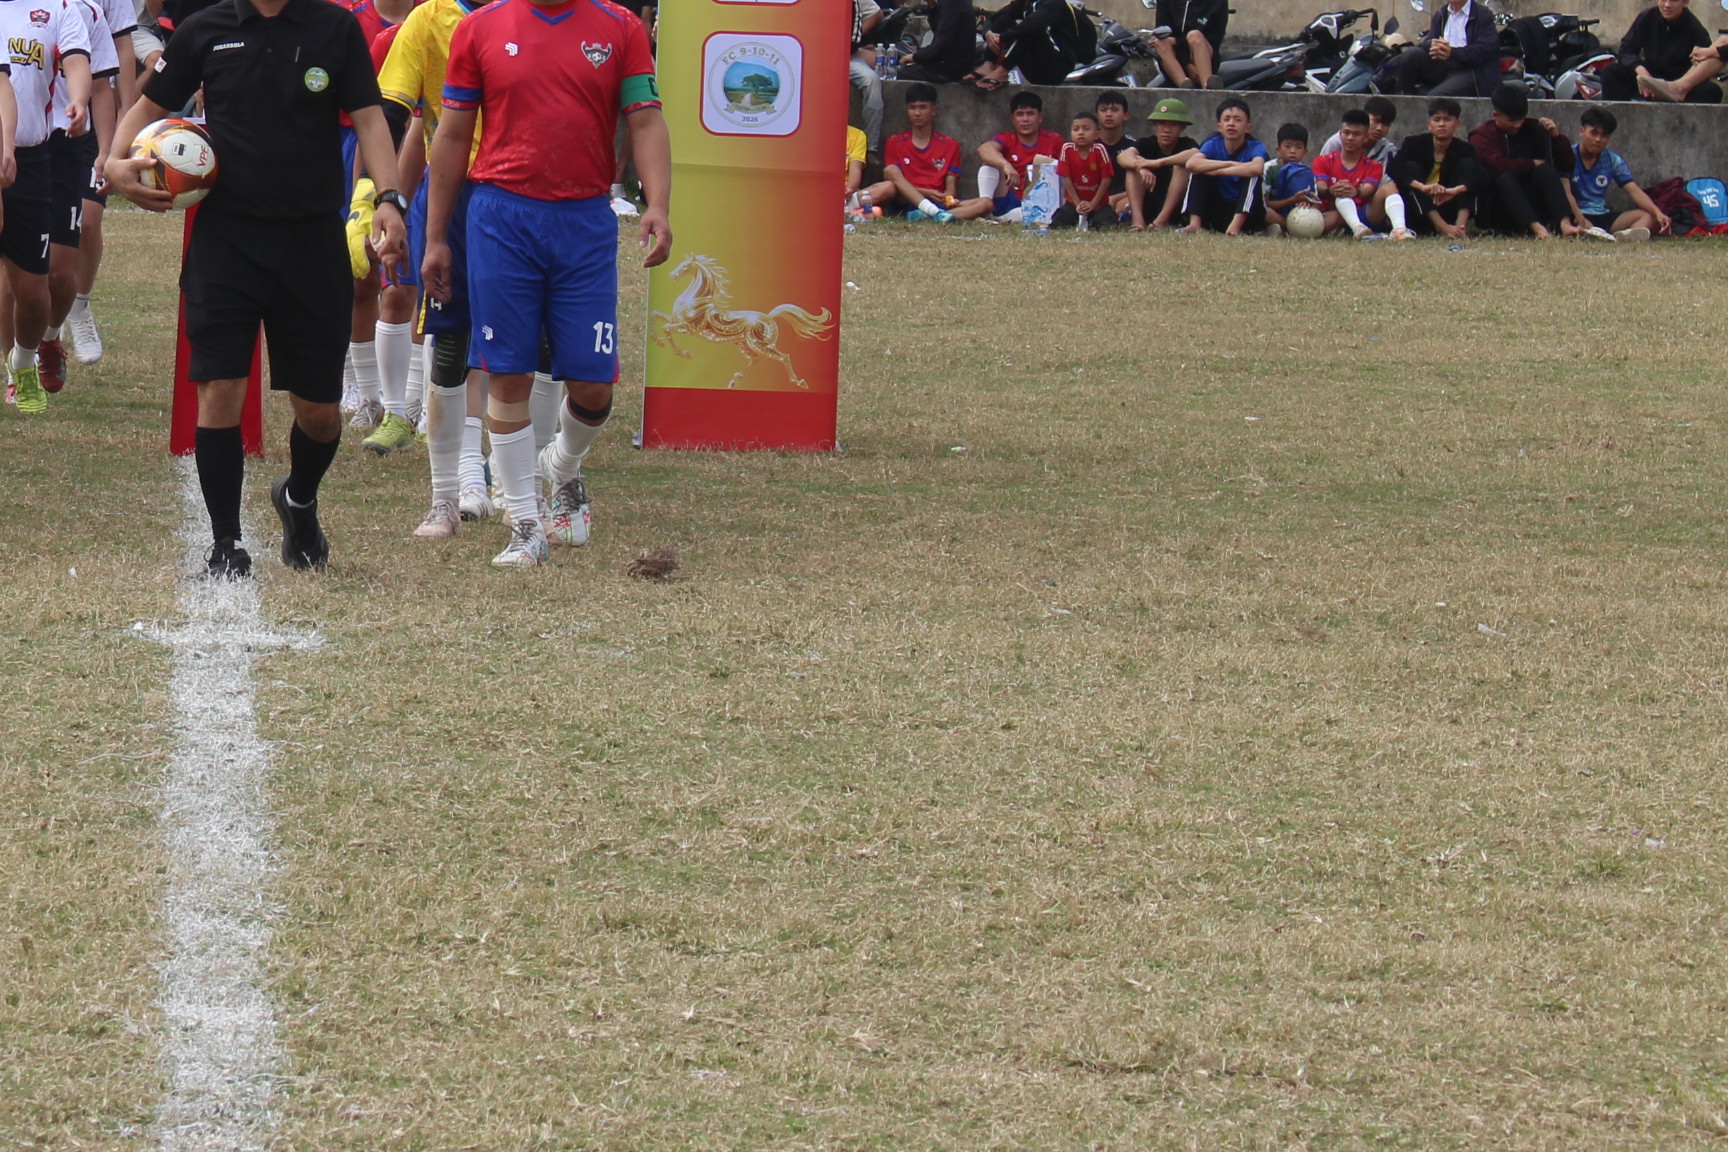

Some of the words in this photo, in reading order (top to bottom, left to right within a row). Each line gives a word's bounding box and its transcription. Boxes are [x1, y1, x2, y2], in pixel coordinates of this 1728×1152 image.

[722, 52, 736, 65] FC
[41, 233, 50, 258] 7
[593, 321, 614, 354] 13
